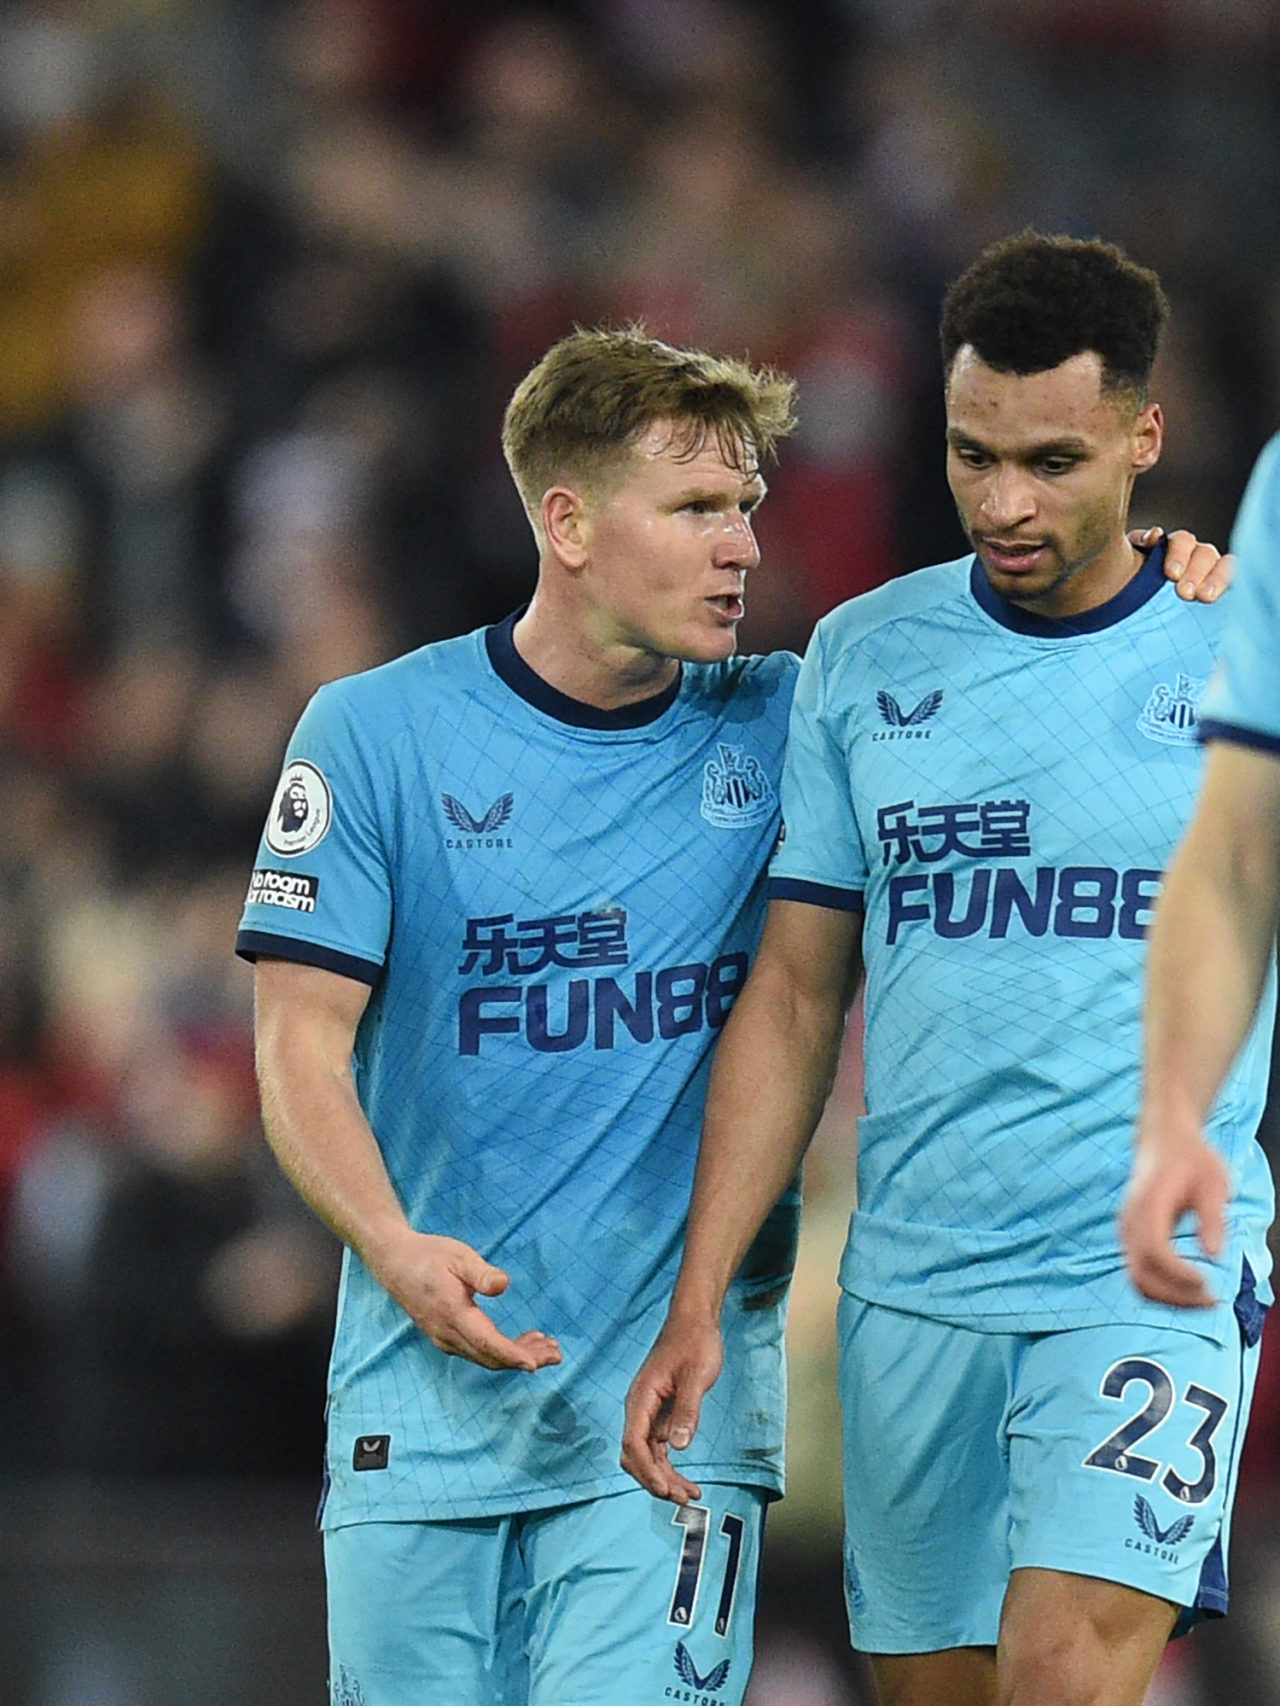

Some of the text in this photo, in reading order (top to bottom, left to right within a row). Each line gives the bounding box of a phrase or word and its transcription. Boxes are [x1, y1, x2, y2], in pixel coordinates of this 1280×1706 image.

[872, 729, 932, 742] CASTORE
[446, 838, 514, 849] CASTORE
[877, 799, 1031, 867] 乐天堂
[263, 871, 311, 896] room
[458, 907, 629, 976] 乐天堂
[458, 951, 749, 1056] FUN88
[1081, 1356, 1229, 1507] 23
[667, 1502, 745, 1639] 11
